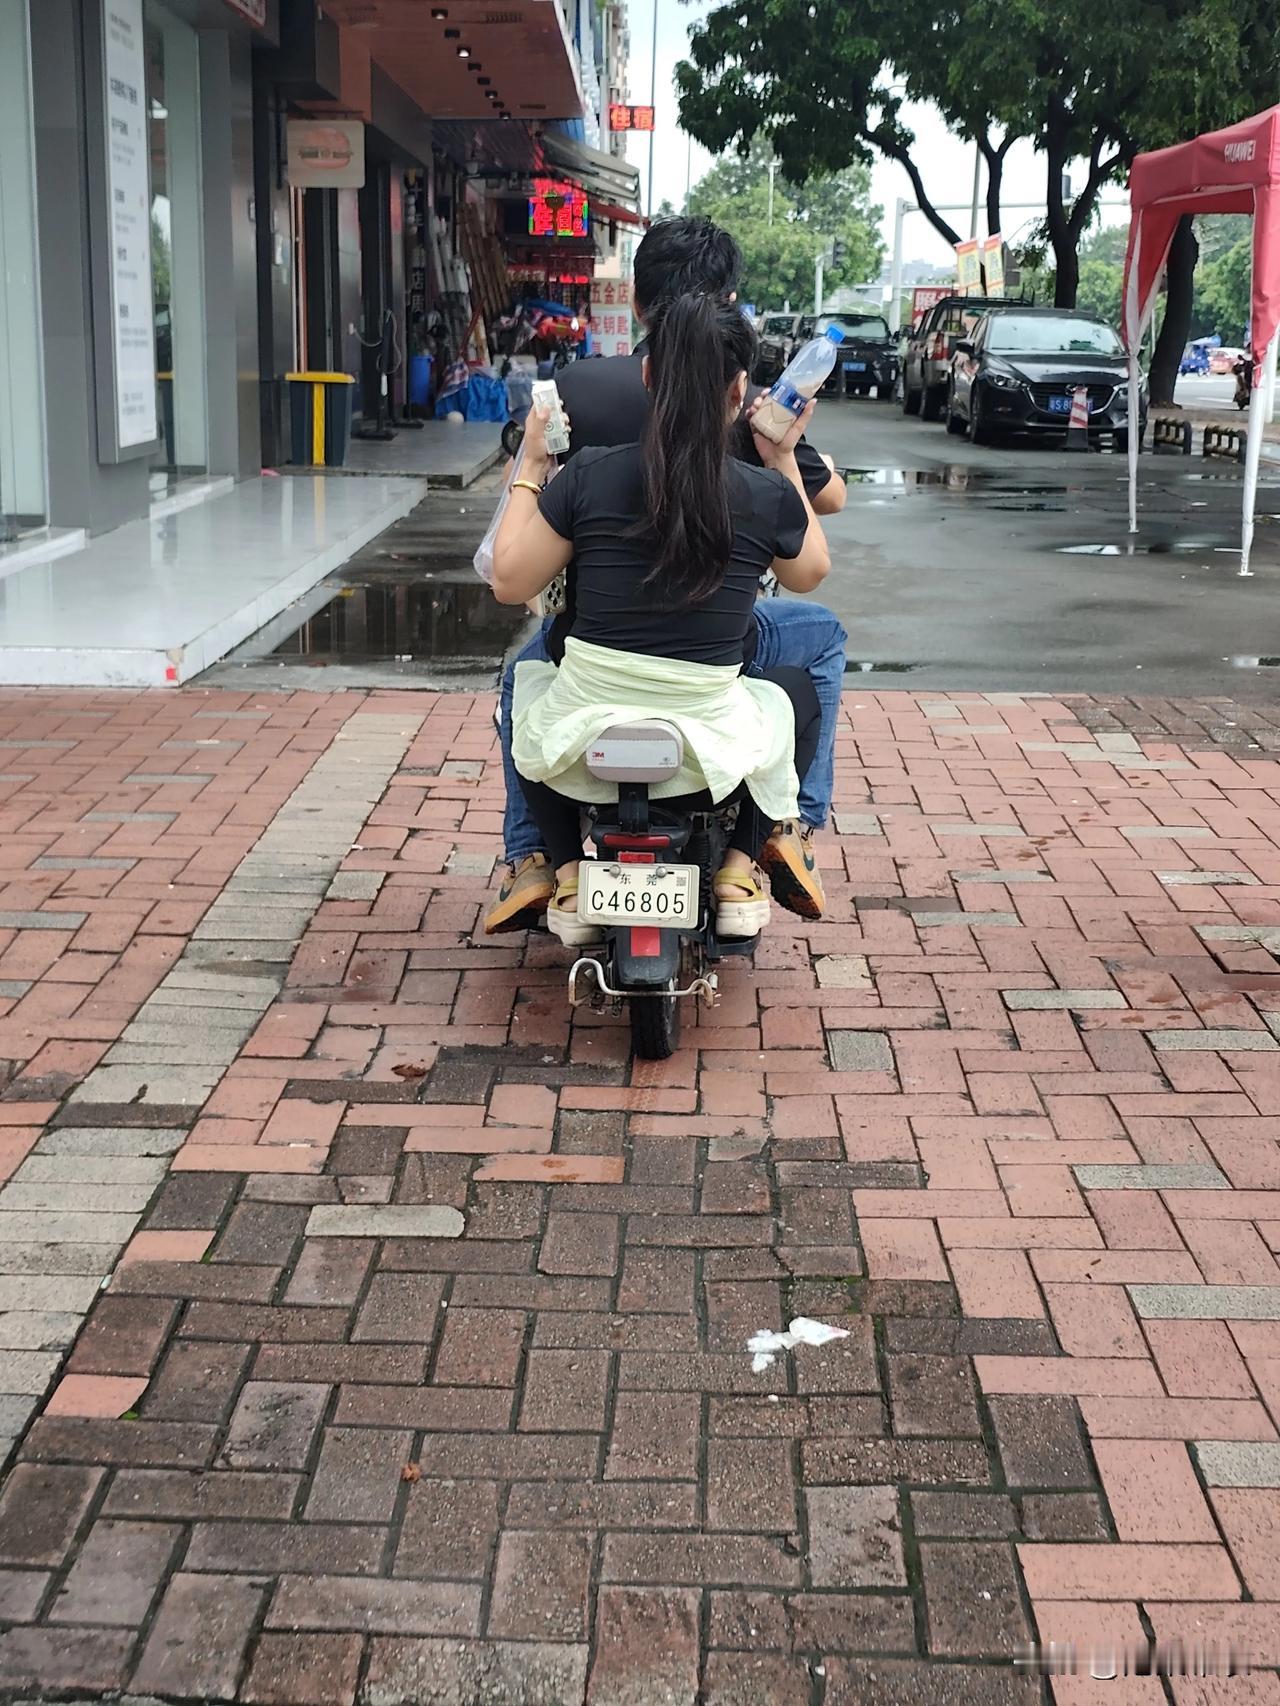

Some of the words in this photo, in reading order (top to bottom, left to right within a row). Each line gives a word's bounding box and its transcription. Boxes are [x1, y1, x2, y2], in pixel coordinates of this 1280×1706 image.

[611, 107, 653, 130] 住宿
[1225, 140, 1255, 162] HUAWEI
[592, 281, 628, 304] 五金店
[591, 890, 685, 914] C46805
